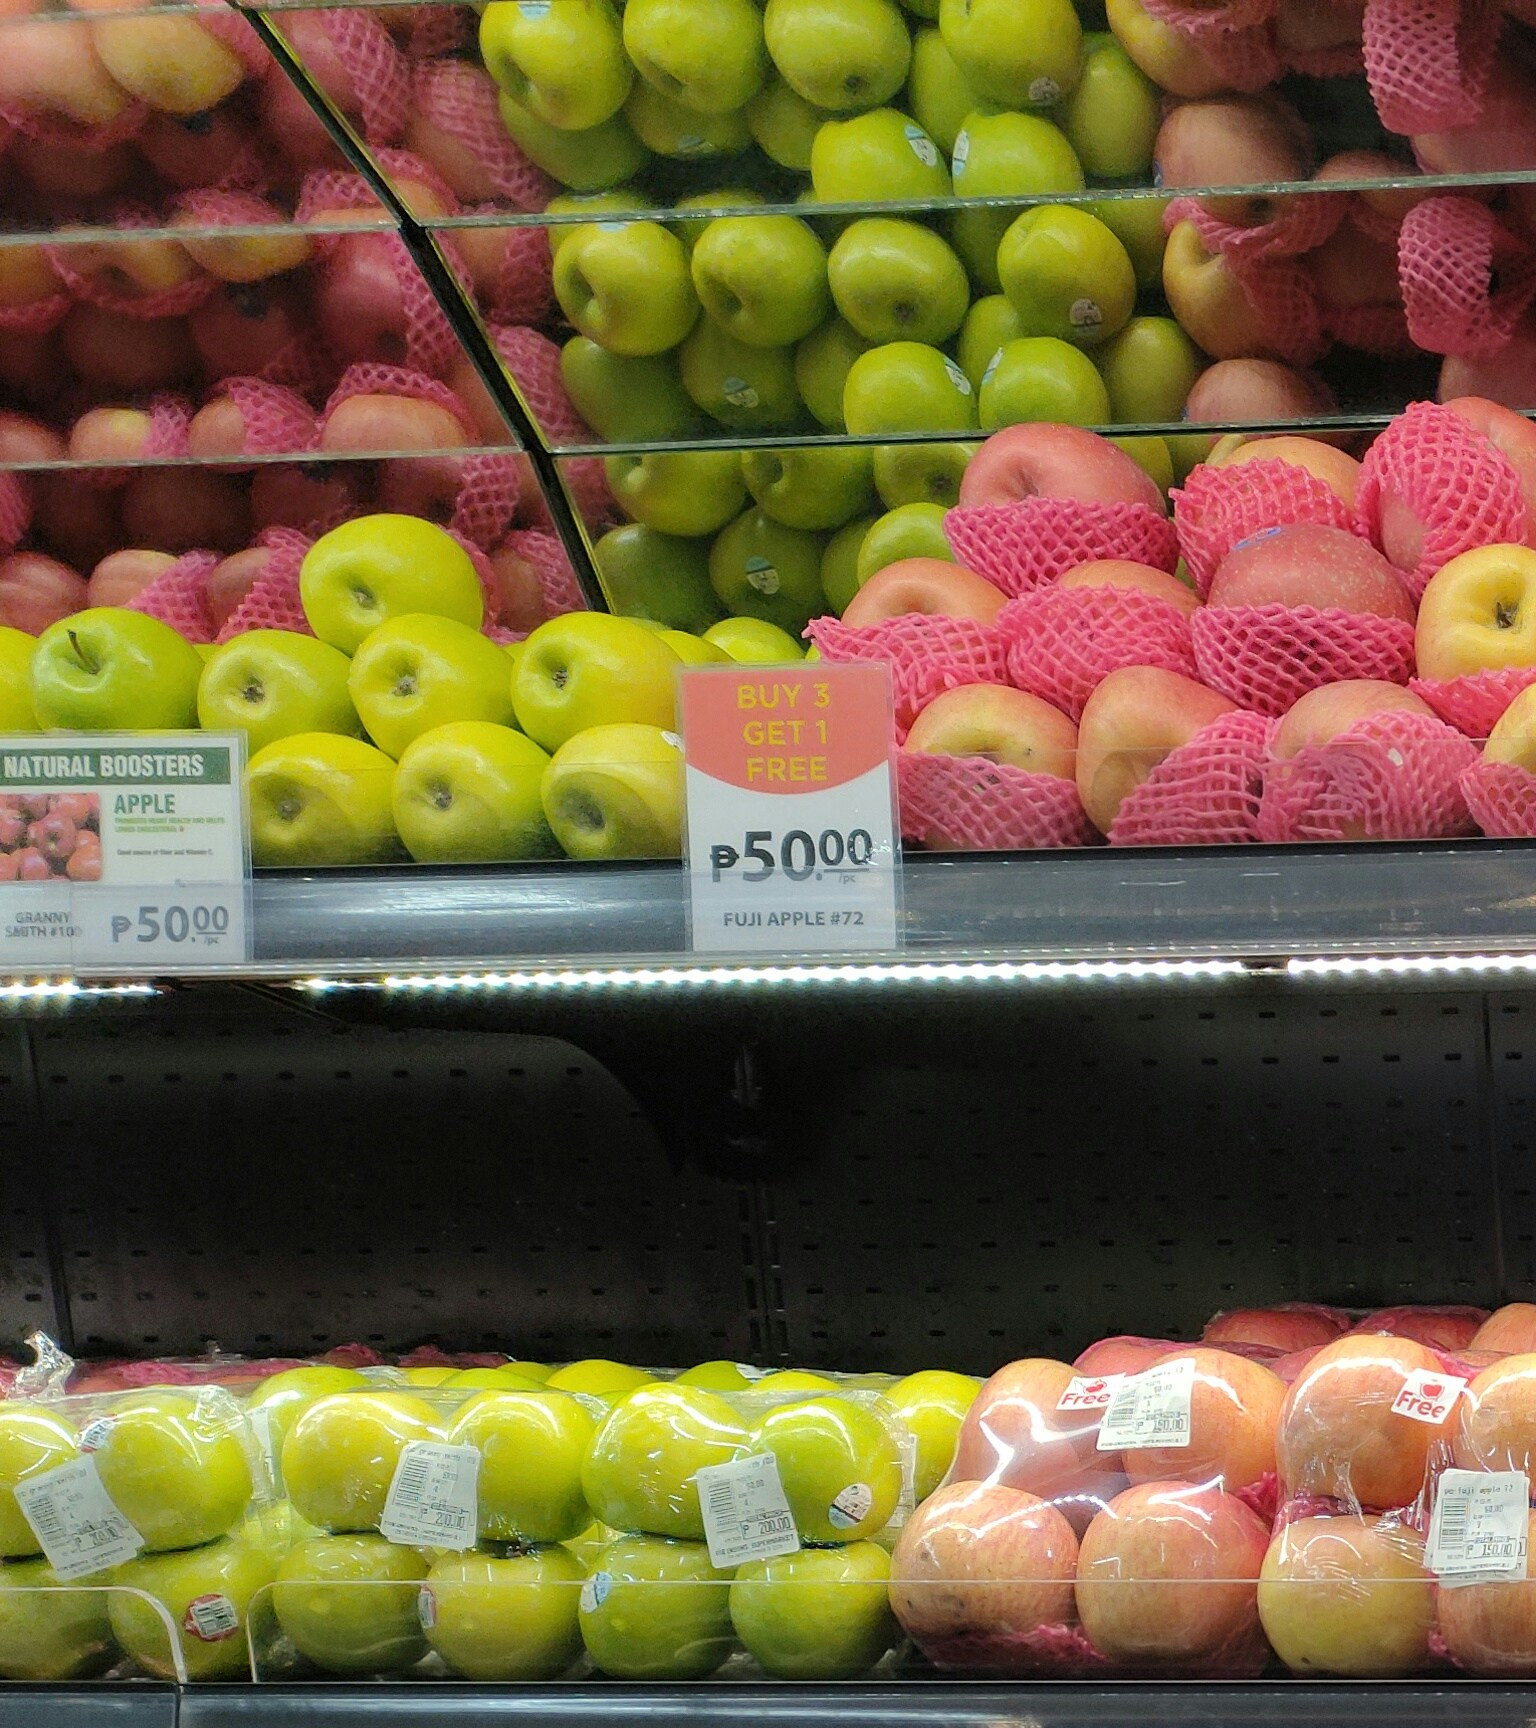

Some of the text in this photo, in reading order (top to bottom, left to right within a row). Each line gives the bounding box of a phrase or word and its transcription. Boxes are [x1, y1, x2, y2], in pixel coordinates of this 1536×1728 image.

[737, 683, 831, 709] BUY 3
[743, 720, 828, 745] GET 1
[4, 754, 204, 778] NATURAL BOOSTERS
[746, 756, 828, 782] FREE
[114, 794, 176, 814] APPLE
[15, 911, 71, 923] GRANNY
[723, 911, 864, 927] FUJI APPLE #72
[1061, 1393, 1110, 1405] Free
[1395, 1391, 1445, 1418] Free
